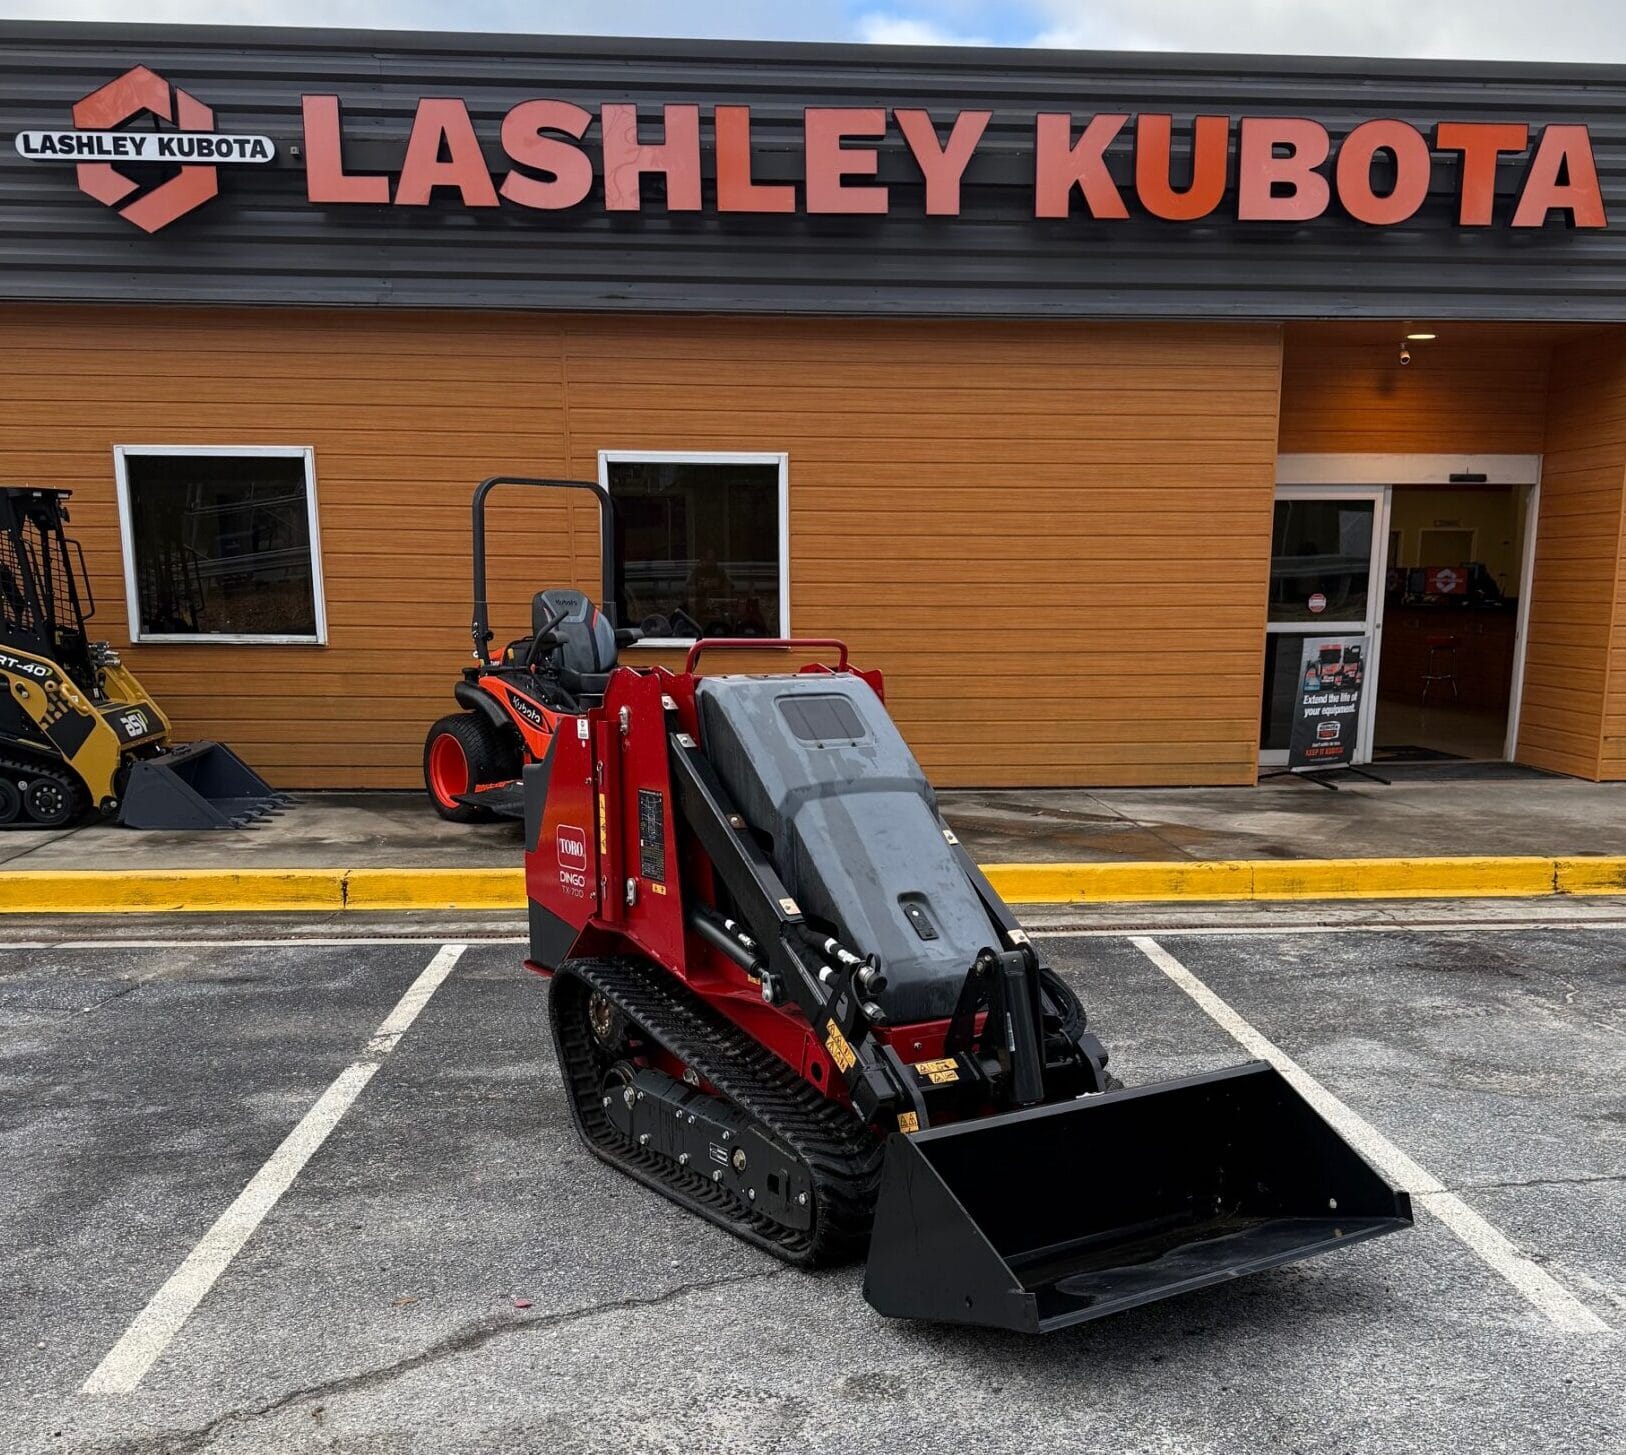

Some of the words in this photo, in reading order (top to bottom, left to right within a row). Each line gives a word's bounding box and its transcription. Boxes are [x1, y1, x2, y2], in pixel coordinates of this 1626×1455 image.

[23, 134, 146, 156] LASHLEY
[157, 136, 269, 158] KUBOTA
[301, 94, 993, 216] LASHLEY
[1034, 112, 1608, 229] KUBOTA
[1303, 693, 1328, 705] Extend
[1328, 693, 1340, 703] the
[512, 695, 541, 724] Kubota
[1304, 707, 1321, 718] your
[559, 838, 584, 857] TORO
[560, 870, 586, 888] DINGO
